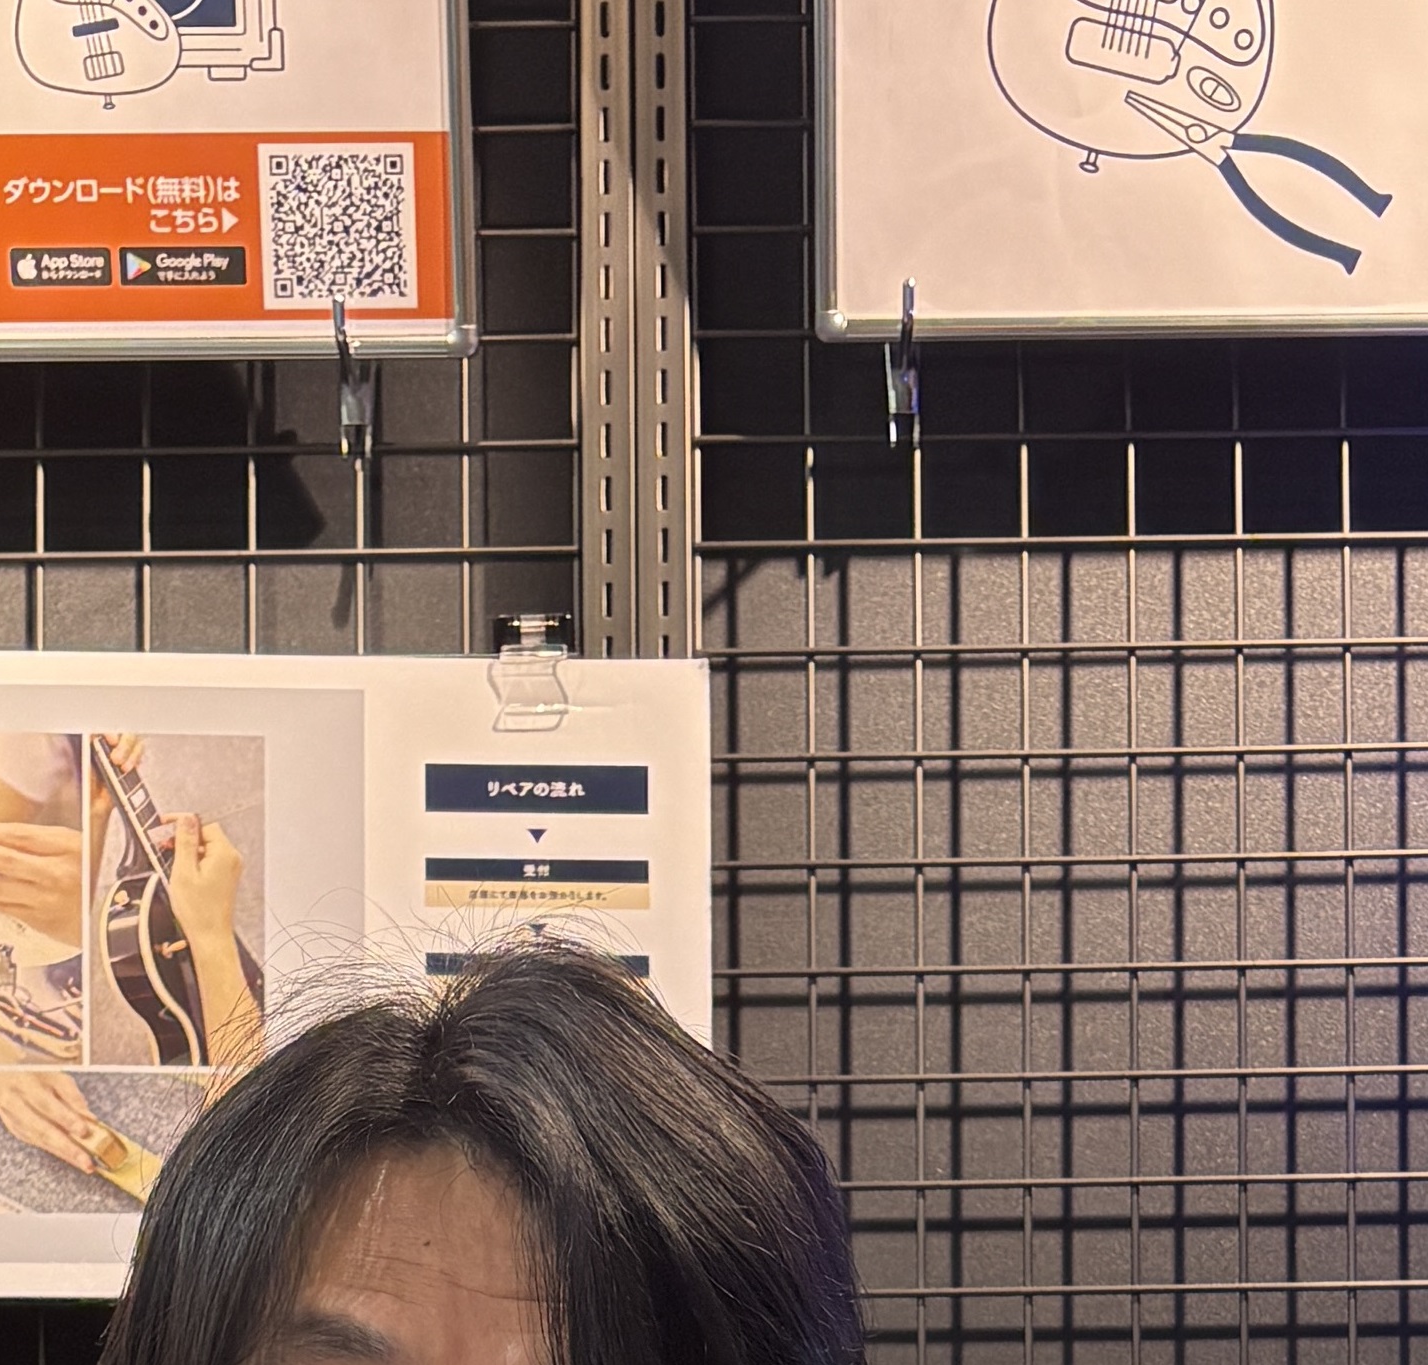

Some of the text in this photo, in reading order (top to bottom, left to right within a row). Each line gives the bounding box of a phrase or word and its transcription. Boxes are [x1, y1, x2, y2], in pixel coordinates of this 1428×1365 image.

[3, 176, 241, 205] ダウンロード(無料)は
[149, 207, 219, 234] こちら
[40, 253, 105, 270] App Store
[155, 252, 230, 271] Google Play
[486, 780, 586, 799] リペアの流れ
